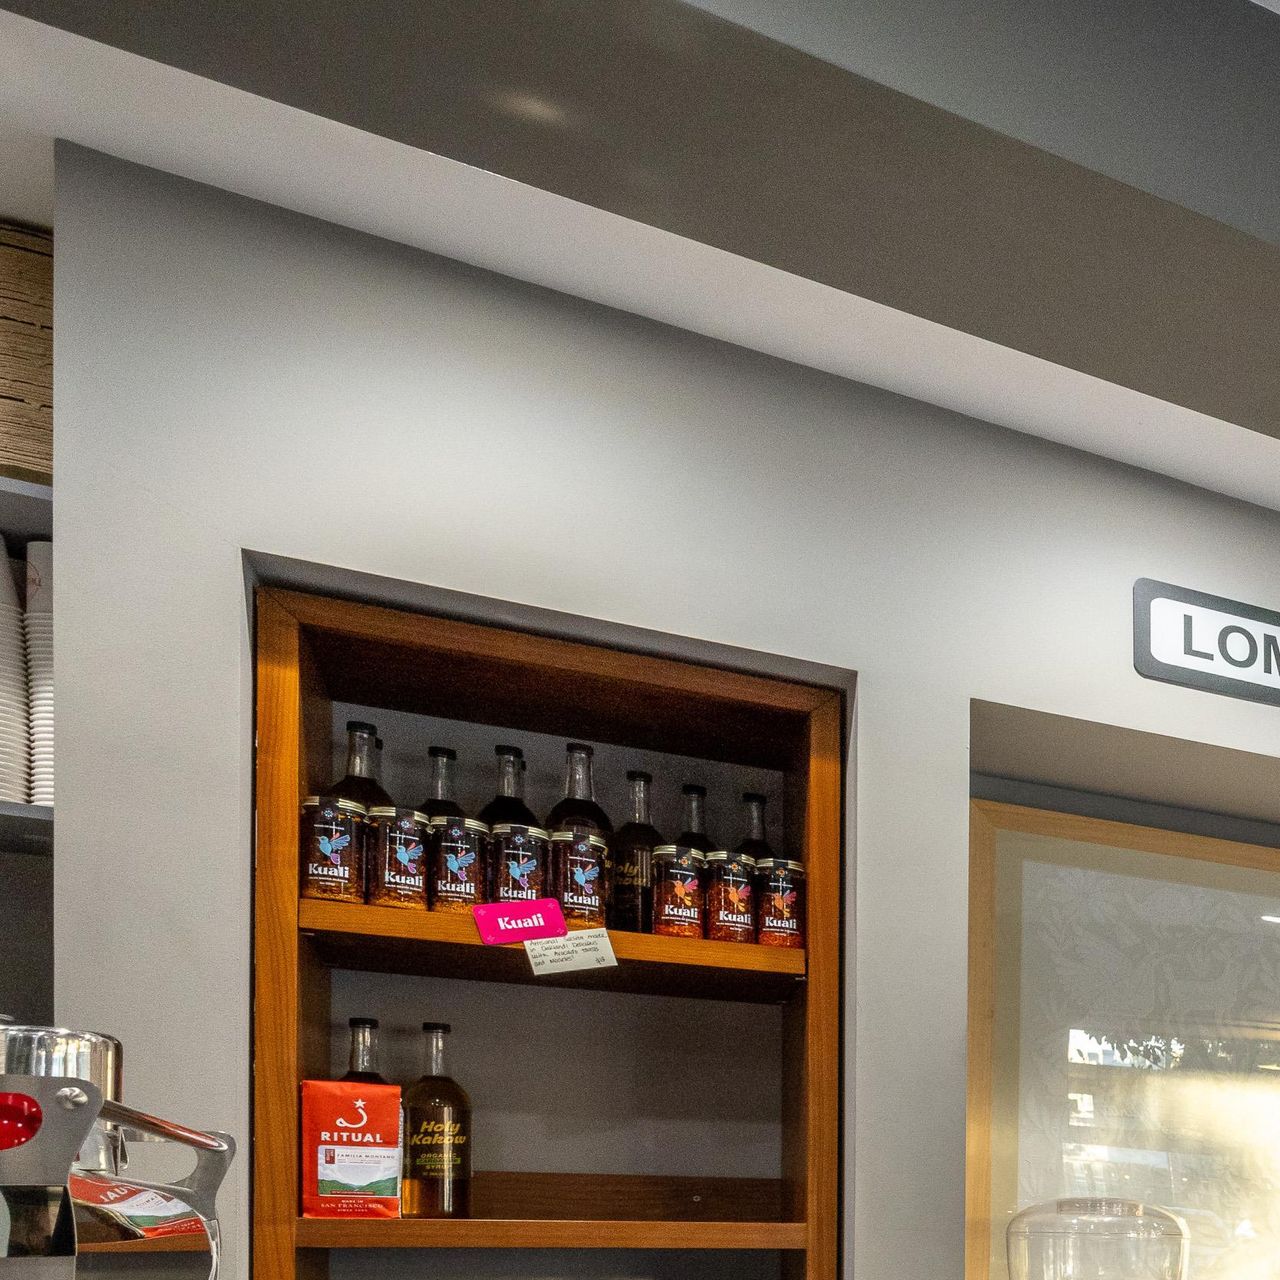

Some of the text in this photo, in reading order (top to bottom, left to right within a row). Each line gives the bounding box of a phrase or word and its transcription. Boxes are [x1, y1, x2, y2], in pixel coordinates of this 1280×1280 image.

[308, 863, 349, 878] Kuali
[385, 871, 422, 887] Kuali
[437, 880, 475, 894] Kuali
[500, 886, 536, 900] Kuali
[564, 892, 599, 906] Kuali
[665, 905, 698, 919] Kuali
[719, 910, 751, 925] Kuali
[498, 913, 545, 930] Kuali
[765, 916, 796, 930] Kuali
[421, 1120, 461, 1135] Holy
[321, 1131, 383, 1143] RITUAL
[411, 1133, 467, 1146] Kakow
